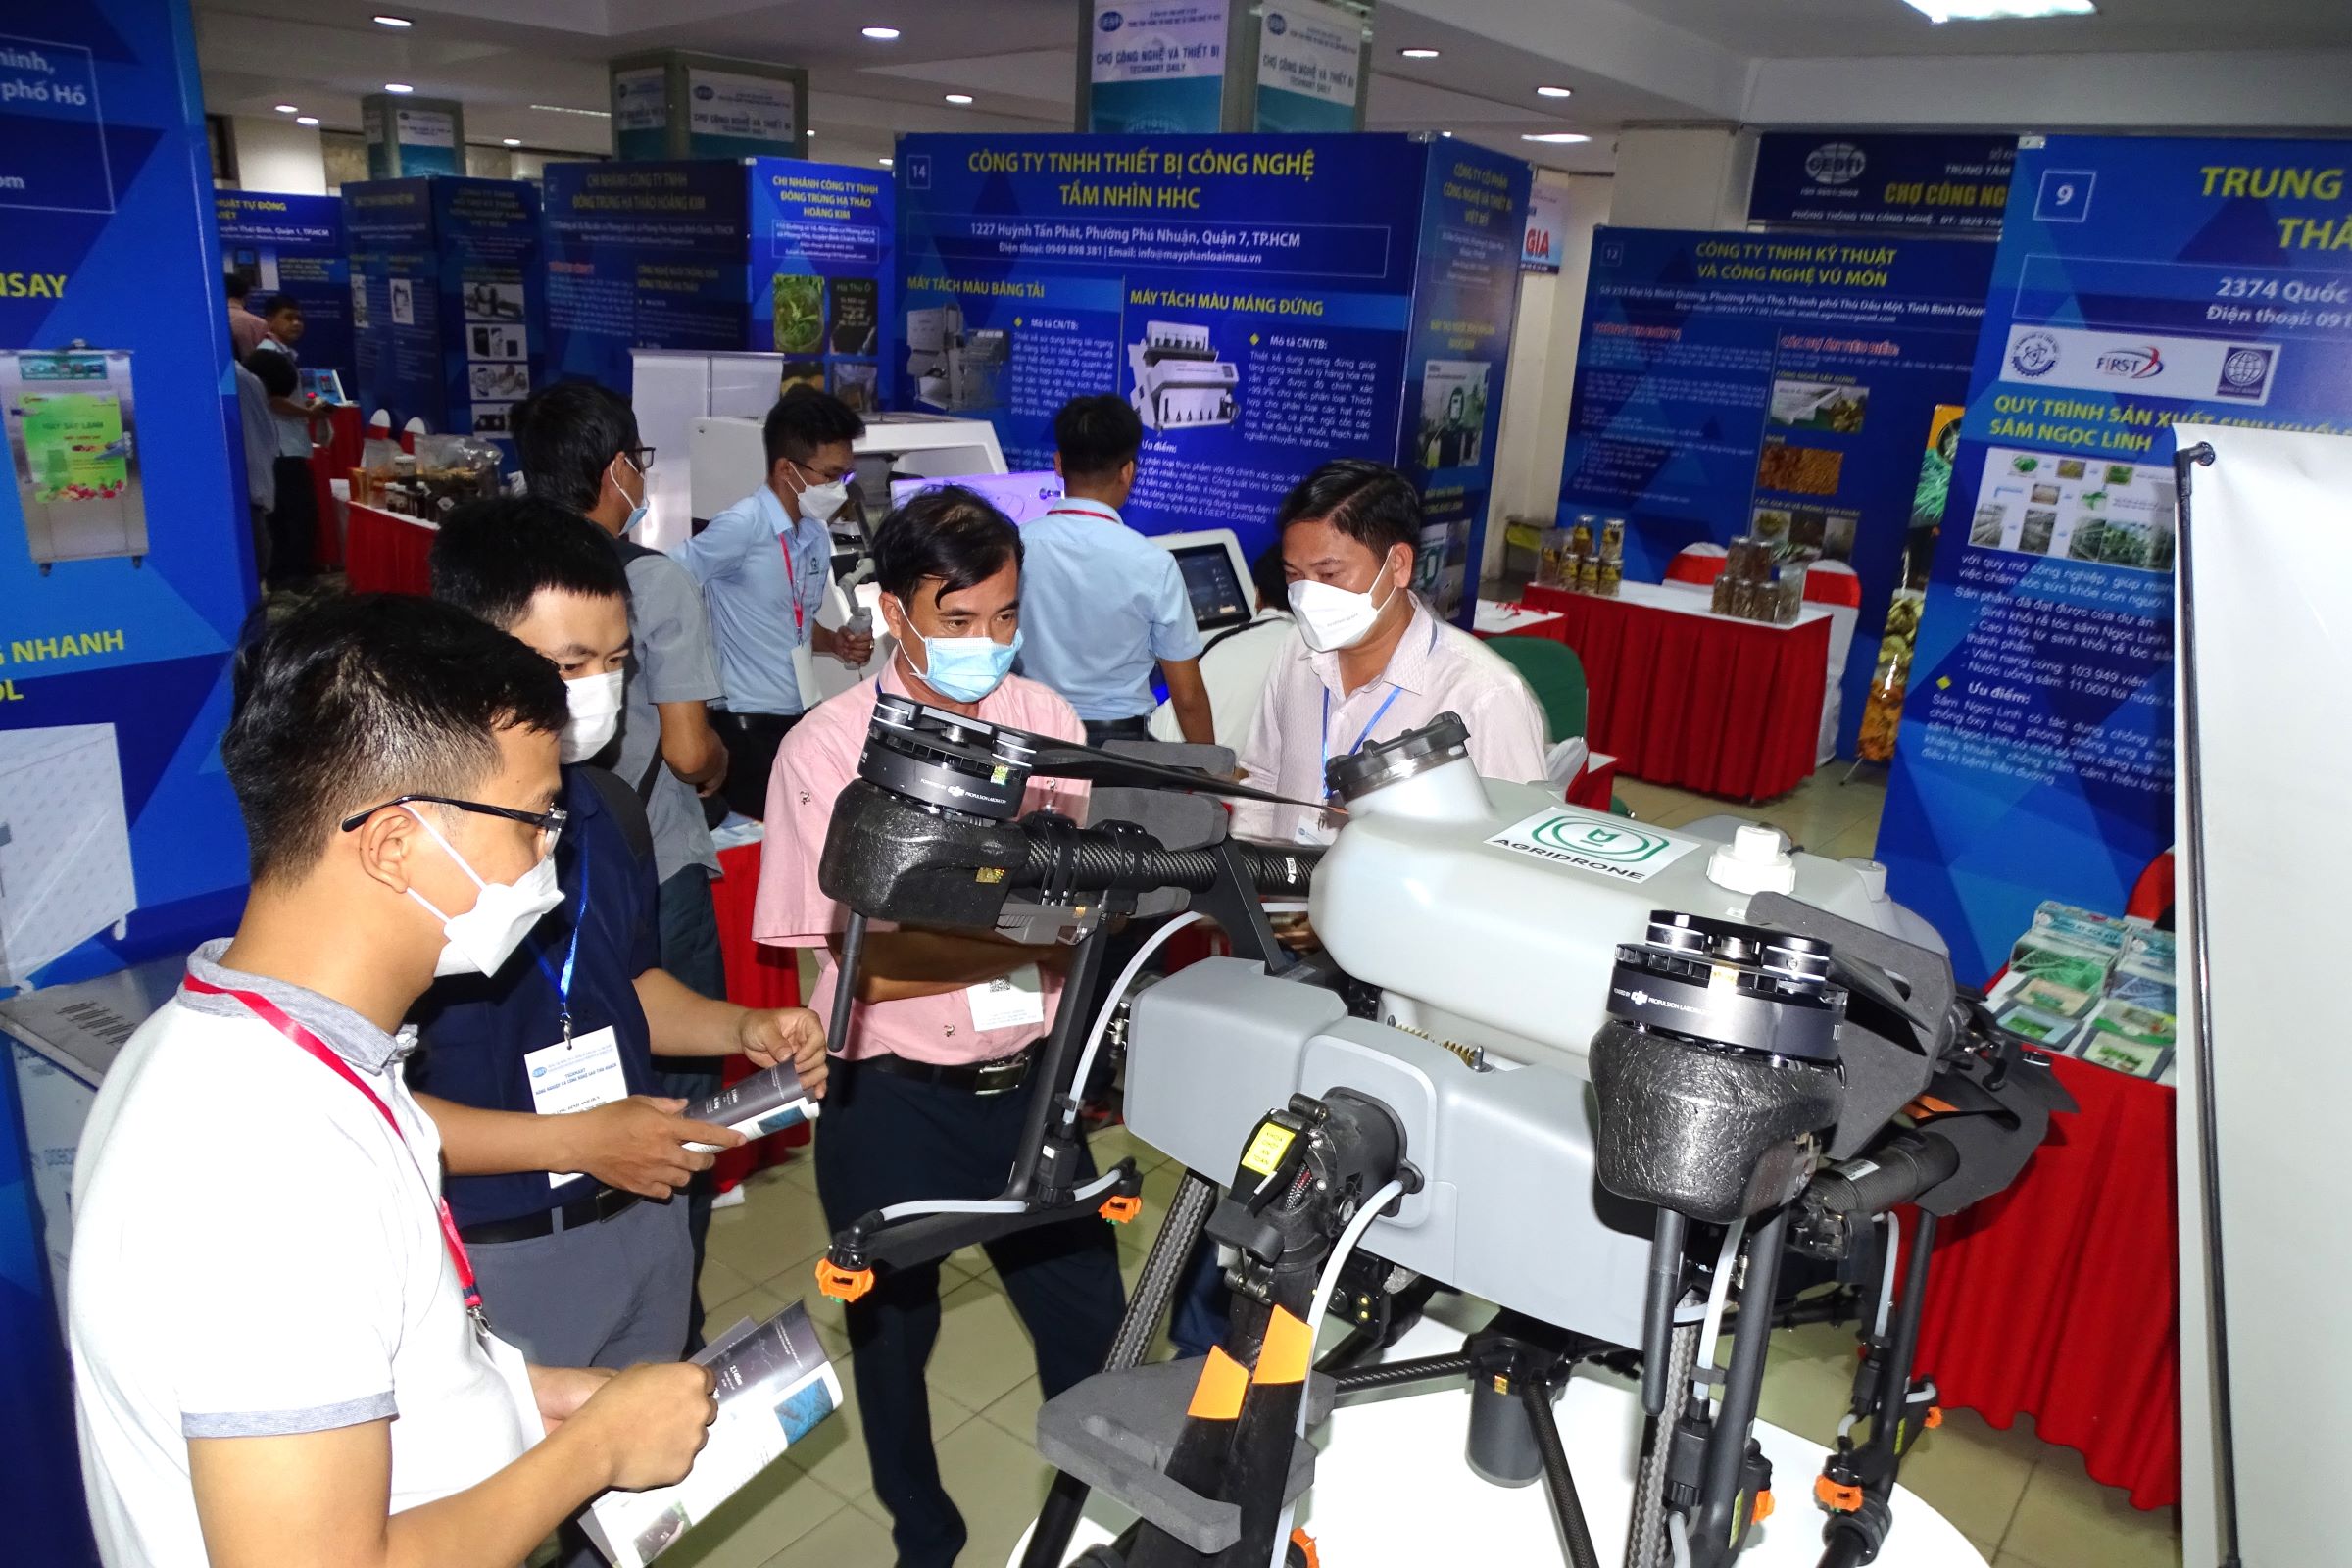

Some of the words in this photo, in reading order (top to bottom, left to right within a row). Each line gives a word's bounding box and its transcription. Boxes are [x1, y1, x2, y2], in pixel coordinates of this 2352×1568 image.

[912, 165, 926, 178] 14
[968, 149, 1018, 172] CÔNG
[1022, 152, 1044, 172] TY
[1049, 153, 1100, 173] TNHH
[1104, 146, 1158, 173] THIẾT
[1164, 153, 1182, 179] BỊ
[1188, 149, 1248, 175] CÔNG
[1252, 149, 1315, 182] NGHỆ
[1944, 165, 1983, 175] TRUNG
[1984, 163, 2010, 176] TÂM
[1059, 178, 1099, 206] TẦM
[1103, 181, 1152, 207] NHÌN
[1157, 186, 1200, 208] HHC
[1884, 182, 1924, 208] CHỢ
[1925, 181, 1978, 206] CÔNG
[2056, 184, 2074, 206] 9
[2200, 166, 2344, 201] TRUNG
[804, 205, 833, 219] HOÀNG
[835, 210, 851, 219] KIM
[970, 221, 995, 235] 1227
[998, 222, 1031, 239] Huỳnh
[1034, 223, 1053, 238] Tấn
[1055, 224, 1083, 240] Phát,
[1085, 225, 1129, 244] Phường
[1131, 226, 1155, 242] Phú
[1157, 228, 1200, 247] Nhuận,
[1202, 229, 1236, 249] Quận
[1239, 231, 1250, 247] 7,
[1252, 231, 1300, 248] TP.HCM
[1526, 226, 1549, 259] GIA
[999, 241, 1018, 255] Điện
[1019, 242, 1044, 256] thoại:
[1045, 243, 1066, 256] 0949
[1067, 244, 1084, 256] 898
[1085, 244, 1102, 257] 381
[1108, 246, 1137, 259] Email:
[1138, 246, 1262, 264] info@mayphanloaimau.vn
[1606, 248, 1618, 260] 12
[1695, 241, 1740, 259] CÔNG
[1743, 245, 1761, 260] TY
[1767, 246, 1811, 262] TNHH
[1815, 244, 1837, 263] KỸ
[1840, 248, 1897, 269] THUẬT
[906, 275, 930, 291] MÁY
[933, 275, 960, 292] TÁCH
[962, 278, 988, 294] MÀU
[1026, 280, 1045, 298] TẢI
[1697, 262, 1717, 278] VÀ
[1720, 263, 1766, 281] CÔNG
[1769, 268, 1813, 287] NGHỆ
[1845, 268, 1887, 287] MÔN
[1130, 289, 1158, 305] MÁY
[1161, 289, 1195, 308] TÁCH
[1198, 291, 1229, 310] MÀU
[1232, 293, 1276, 313] MÁNG
[1278, 295, 1323, 316] ĐỨNG
[2216, 277, 2277, 299] 2374
[2283, 277, 2349, 305] Quốc
[2206, 304, 2250, 323] Điện
[2256, 306, 2311, 327] thoại:
[1270, 335, 1284, 348] Mô
[1286, 335, 1296, 348] tả
[1296, 336, 1328, 350] CN/TB:
[2096, 356, 2140, 373] FIRST
[1994, 394, 2035, 416] QUY
[2043, 396, 2104, 421] TRÌNH
[2109, 401, 2152, 427] SẢN
[1989, 416, 2034, 440] SÂM
[2037, 425, 2098, 450] NGỌC
[2102, 431, 2153, 451] LINH
[1961, 553, 1981, 565] với
[1983, 557, 2004, 571] quy
[2008, 561, 2028, 572] mô
[2031, 564, 2060, 579] công
[2063, 567, 2107, 585] nghiệp,
[2113, 575, 2140, 591] giúp
[1979, 606, 2007, 619] Sinh
[2009, 609, 2034, 625] khối
[2035, 613, 2049, 627] rễ
[2050, 616, 2070, 631] tóc
[2072, 621, 2099, 635] sâm
[2102, 626, 2134, 643] Ngọc
[2137, 630, 2167, 646] Linh
[11, 629, 124, 663] NHANH
[1967, 680, 1989, 697] Ưu
[1990, 685, 2031, 705] điểm:
[1493, 837, 1646, 881] AGRIDRONE
